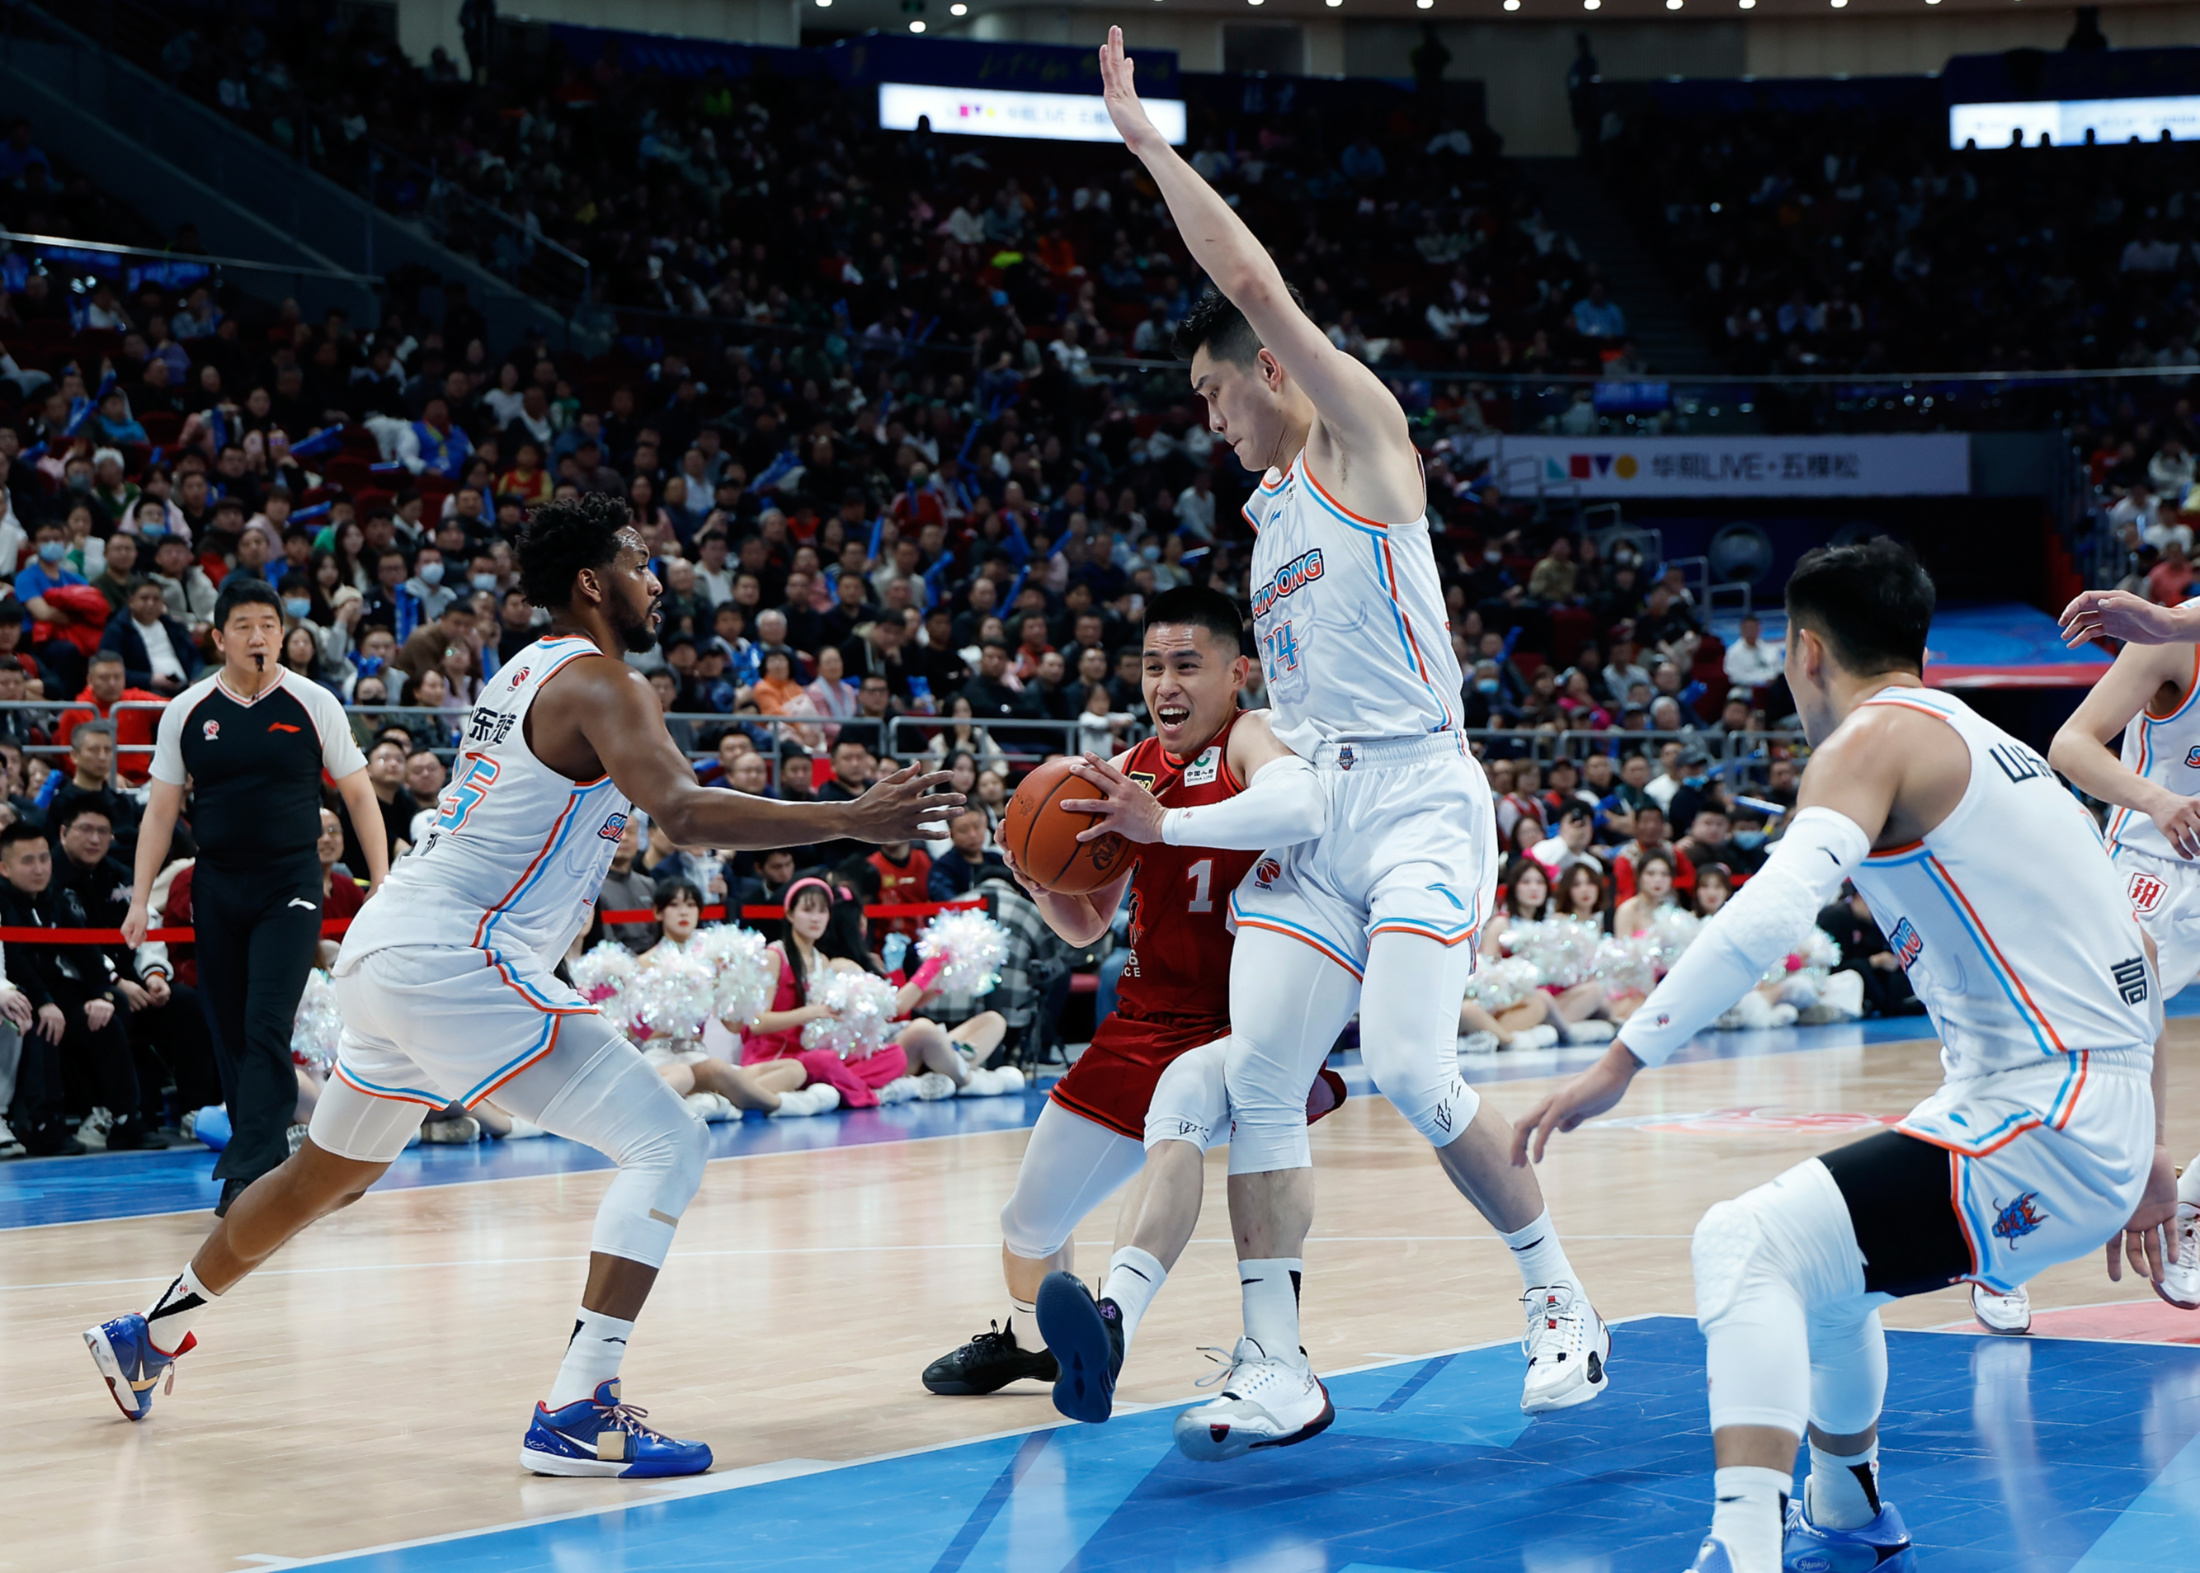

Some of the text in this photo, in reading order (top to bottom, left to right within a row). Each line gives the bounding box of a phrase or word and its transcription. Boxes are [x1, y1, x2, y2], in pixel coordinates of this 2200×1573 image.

[1263, 619, 1299, 683] 14
[1187, 857, 1214, 915] 1
[2110, 955, 2148, 1007] 高
